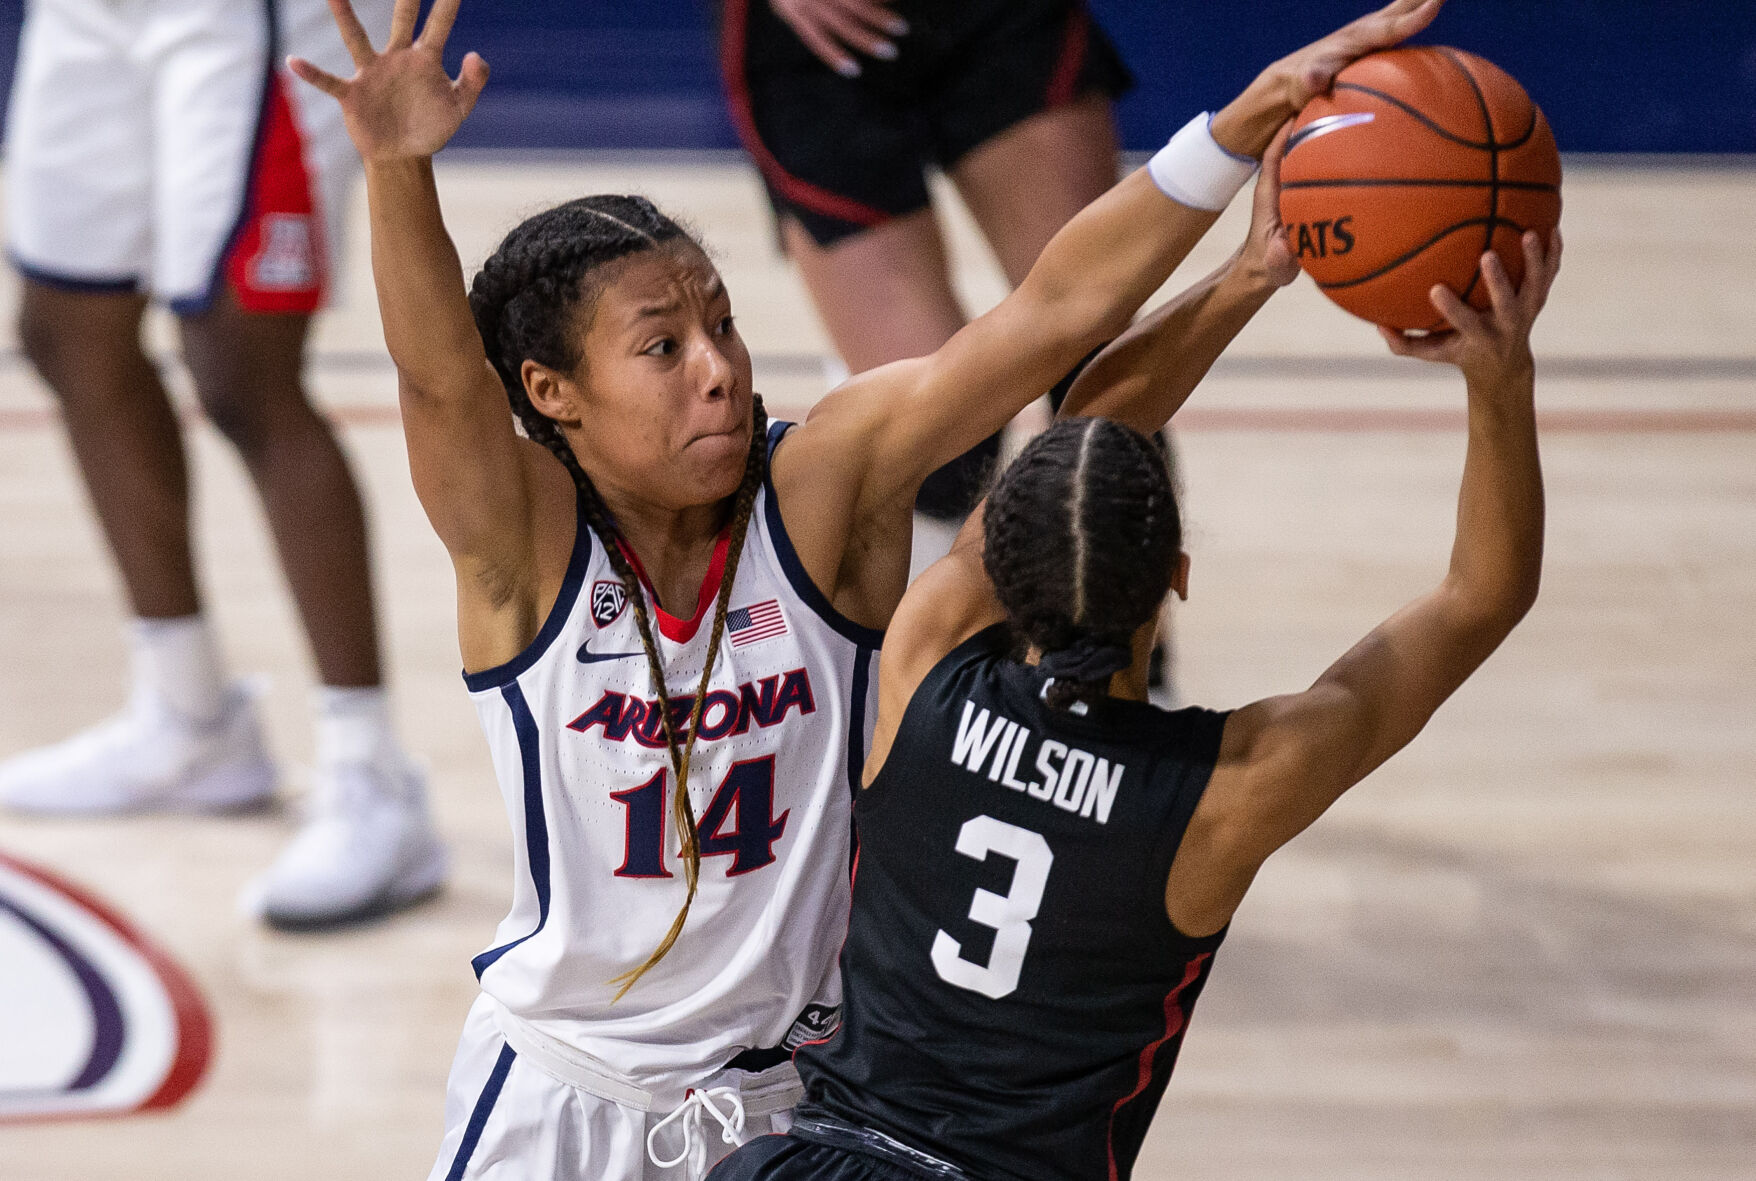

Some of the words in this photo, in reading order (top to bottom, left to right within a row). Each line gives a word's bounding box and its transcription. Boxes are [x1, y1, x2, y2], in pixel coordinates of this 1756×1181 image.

[1286, 215, 1355, 258] ATS
[593, 583, 626, 613] PAC
[595, 601, 614, 620] 12
[566, 667, 816, 748] ARIZONA
[951, 700, 1125, 825] WILSON
[609, 753, 791, 878] 14
[930, 814, 1054, 1000] 3
